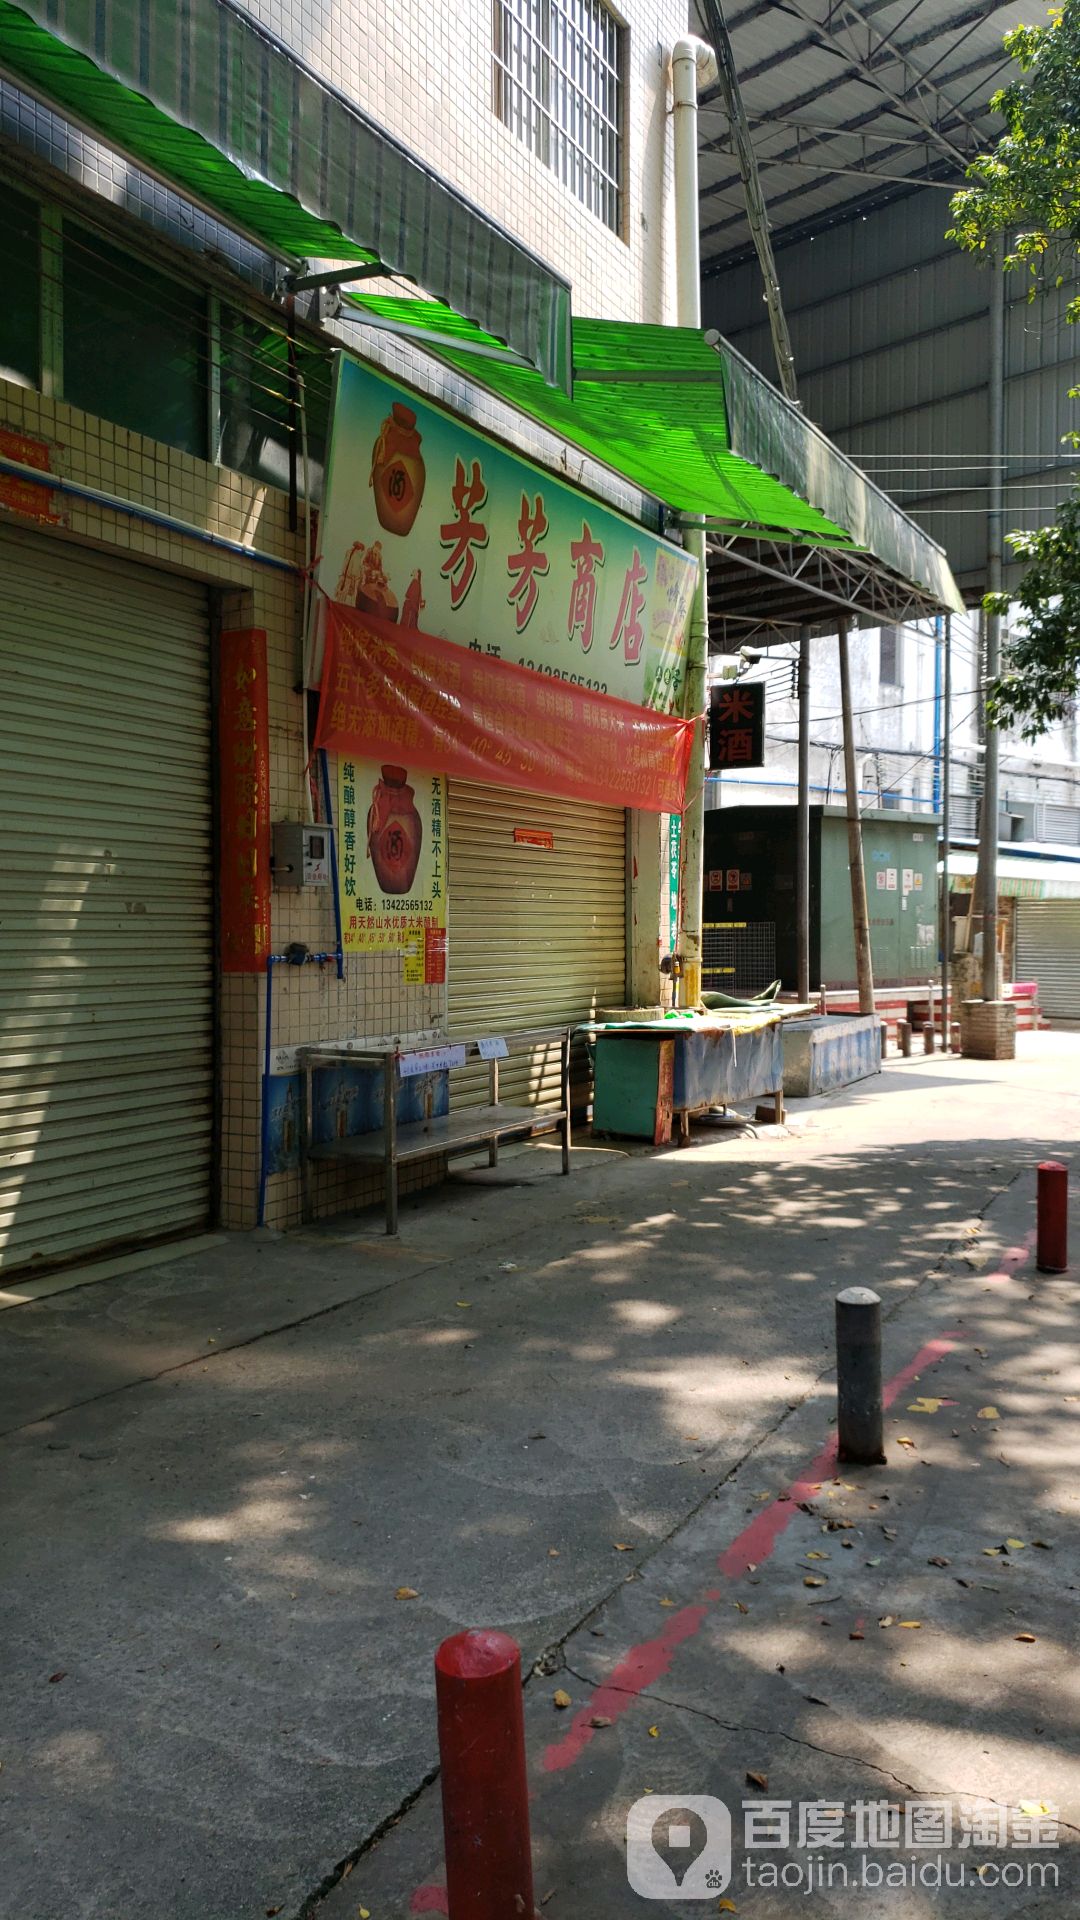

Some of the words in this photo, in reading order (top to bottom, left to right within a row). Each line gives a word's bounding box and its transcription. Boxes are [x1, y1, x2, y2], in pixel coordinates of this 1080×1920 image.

[438, 455, 648, 667] 芳芳商店
[718, 690, 754, 762] 米酒
[343, 762, 356, 897] 纯酿醇香好饮
[431, 777, 442, 899] 无酒精不上头
[350, 915, 438, 929] 用天然山水优质大米酿制
[382, 899, 433, 911] 13422565132
